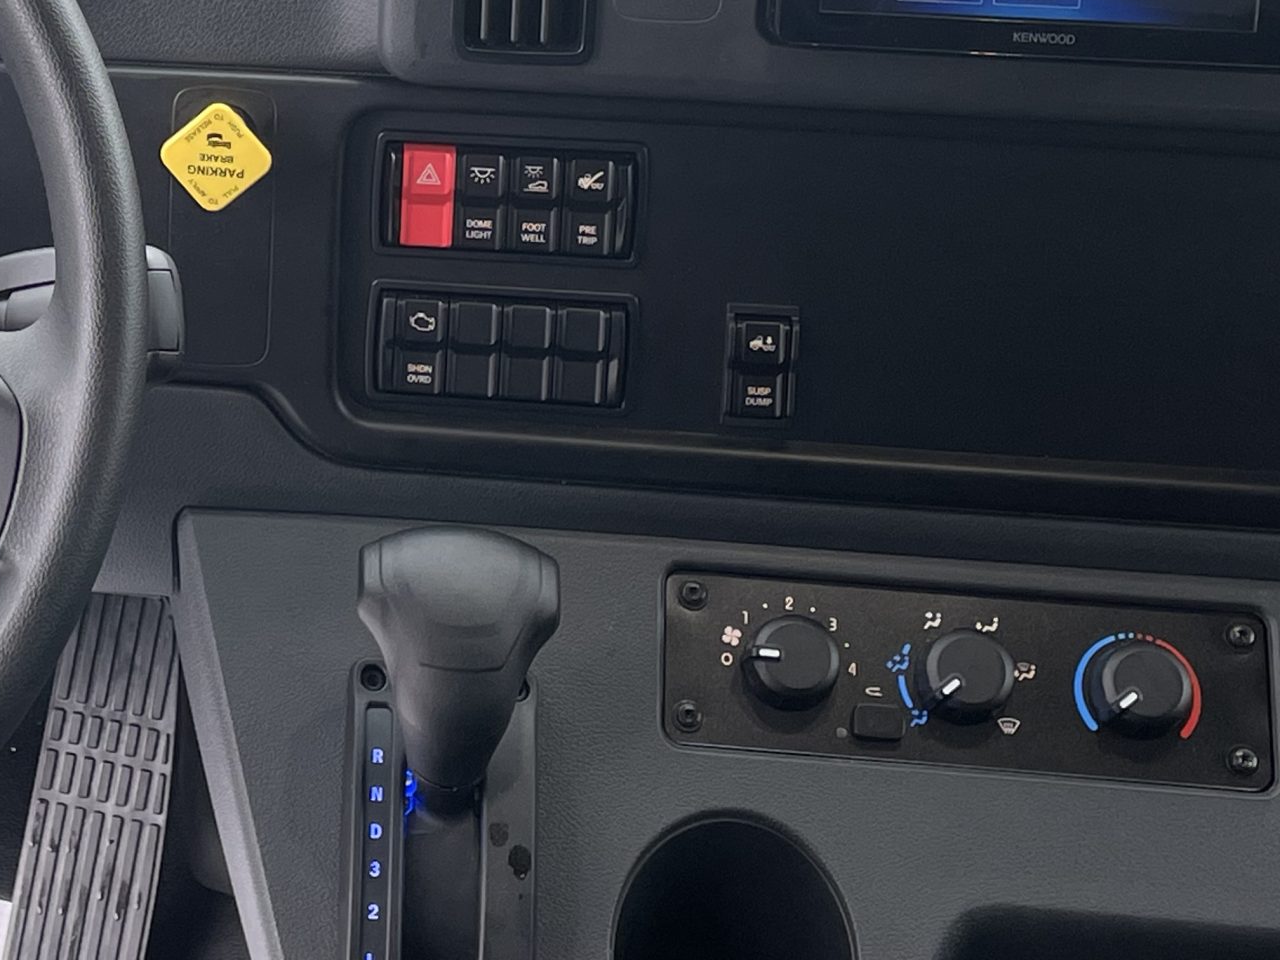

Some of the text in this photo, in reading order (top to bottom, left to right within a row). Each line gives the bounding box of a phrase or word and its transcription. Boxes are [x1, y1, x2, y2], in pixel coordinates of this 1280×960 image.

[1012, 31, 1076, 45] KENWOOD
[199, 152, 234, 164] BRAKE
[187, 164, 245, 179] PARKING
[466, 219, 493, 230] DOME
[521, 222, 547, 233] FOOT
[578, 224, 597, 235] PRE
[465, 229, 492, 240] LIGHT
[520, 232, 547, 244] WELL
[577, 235, 598, 246] TRIP
[784, 597, 794, 611] 2
[742, 610, 750, 624] 1
[828, 617, 838, 631] 3
[847, 661, 858, 677] 4
[371, 748, 384, 764] R
[370, 786, 383, 802] N
[369, 823, 382, 839] D
[369, 861, 381, 877] 3
[367, 904, 379, 920] 2
